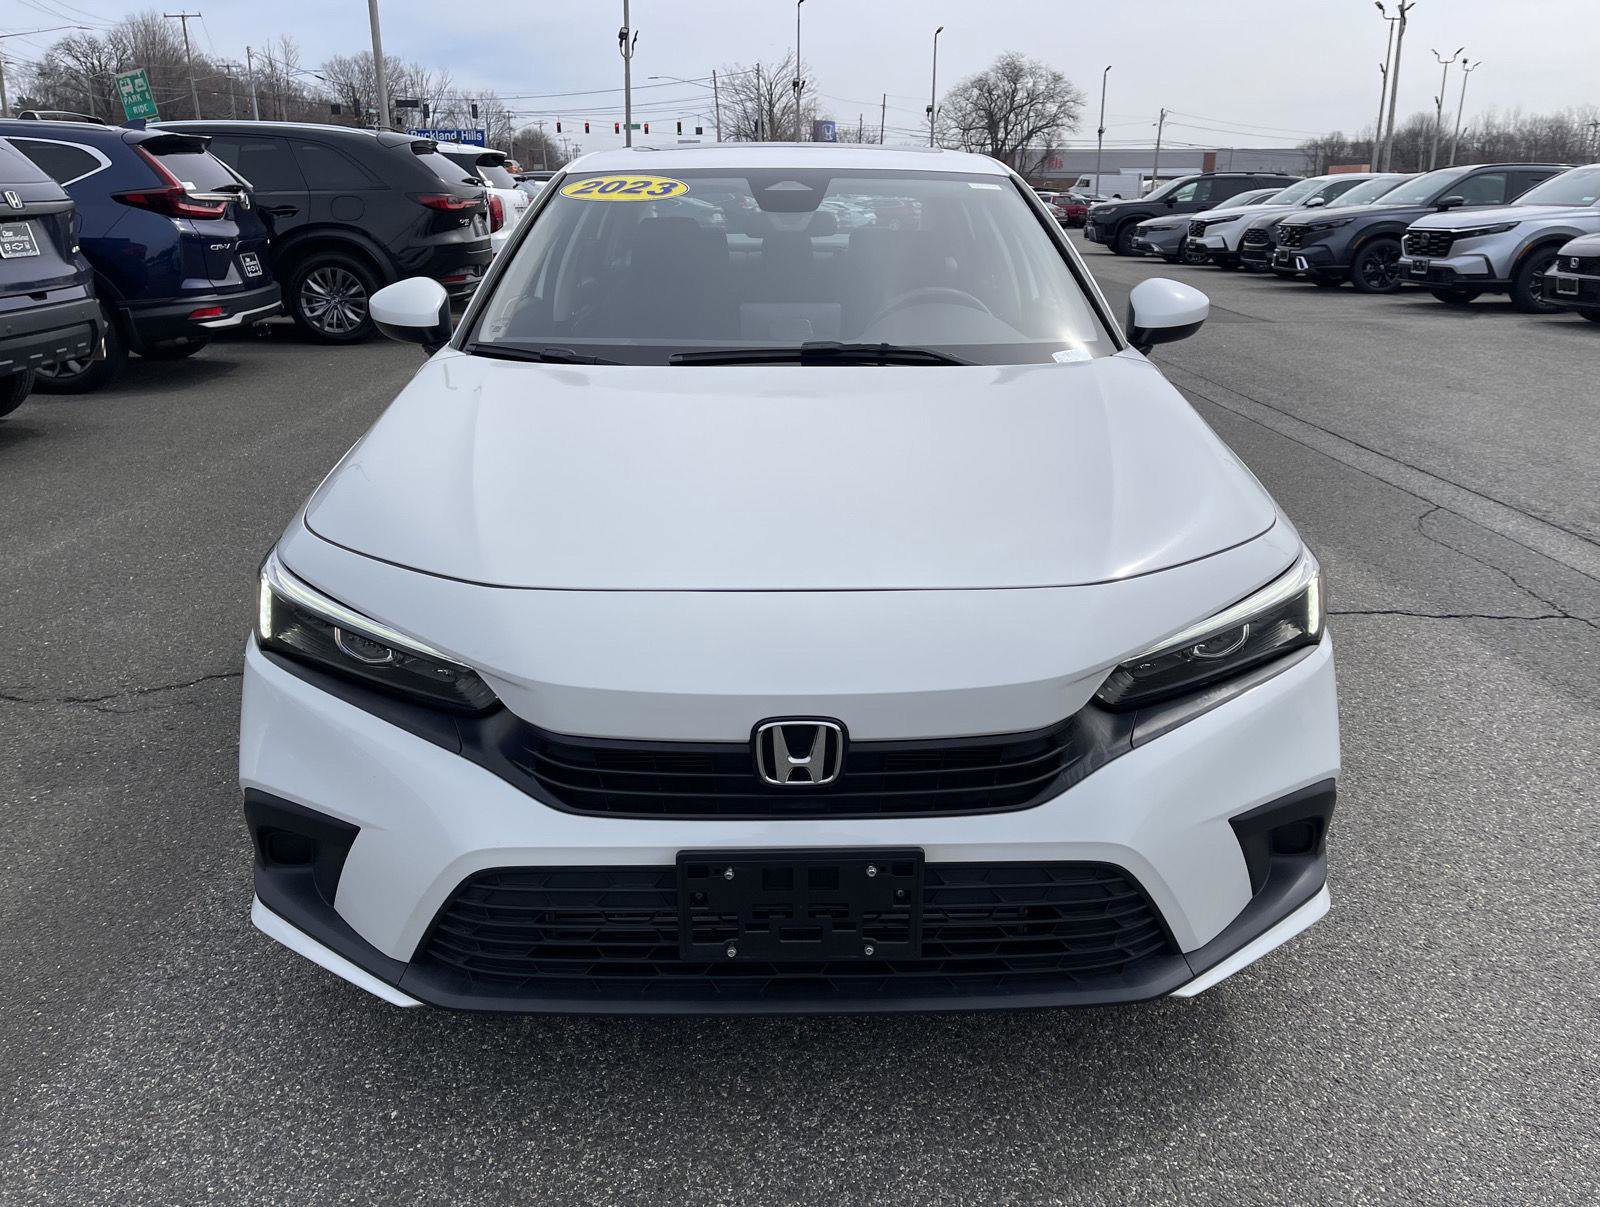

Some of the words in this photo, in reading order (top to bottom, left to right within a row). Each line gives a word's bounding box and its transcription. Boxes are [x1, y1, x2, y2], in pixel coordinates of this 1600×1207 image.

[123, 94, 142, 105] PARK
[132, 103, 149, 114] RIDE
[461, 130, 482, 141] Hills
[570, 180, 678, 196] 2023
